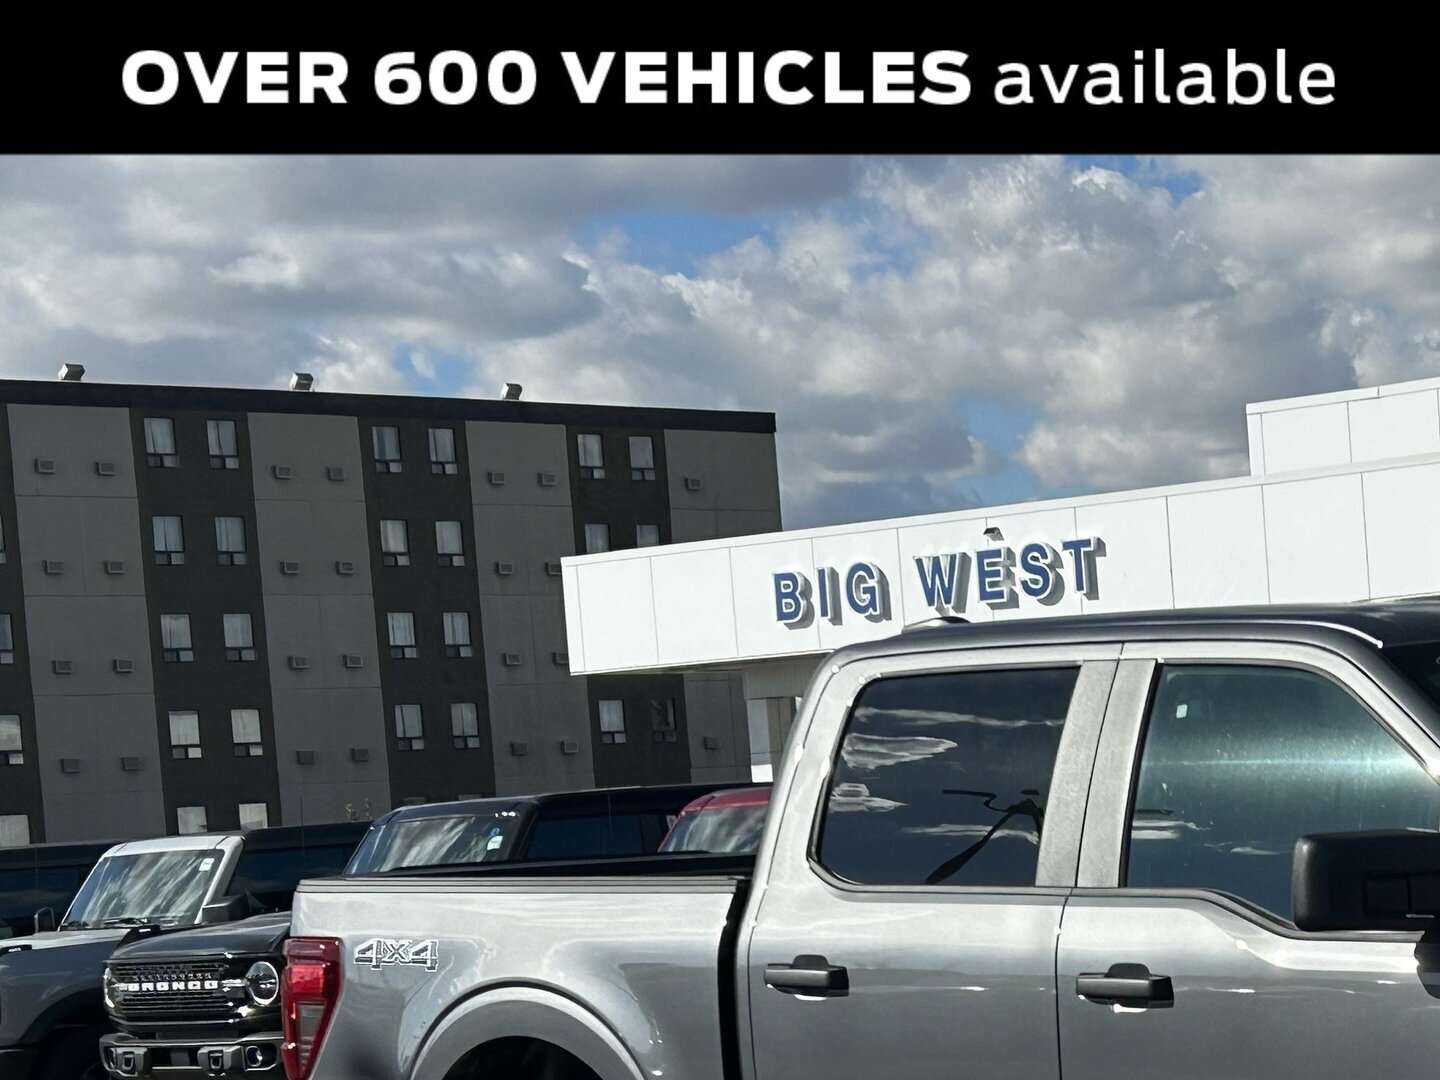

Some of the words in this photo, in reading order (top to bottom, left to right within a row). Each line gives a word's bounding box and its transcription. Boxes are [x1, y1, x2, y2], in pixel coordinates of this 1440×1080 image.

[773, 561, 892, 631] BIG
[914, 536, 1106, 618] WEST
[128, 980, 219, 992] BRONCO
